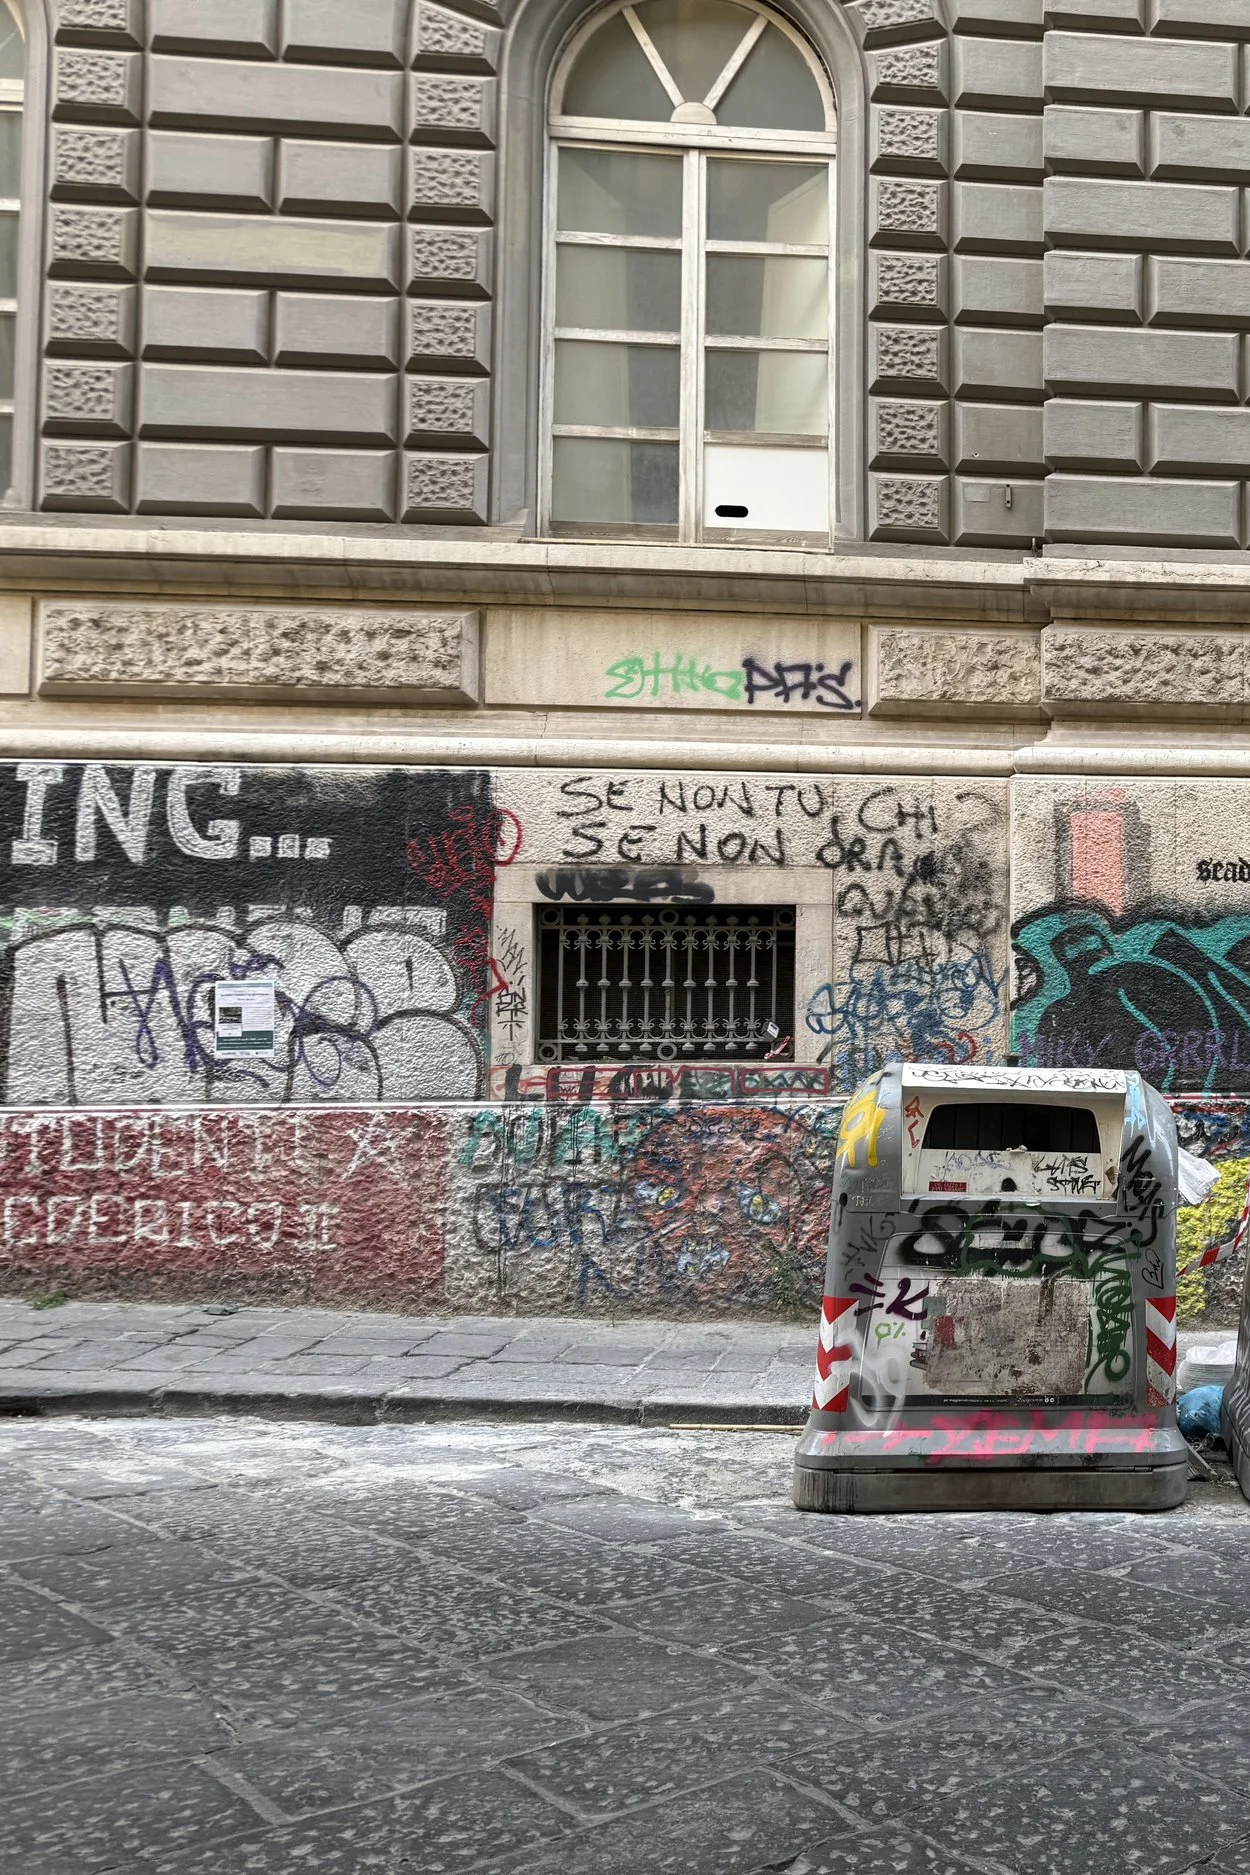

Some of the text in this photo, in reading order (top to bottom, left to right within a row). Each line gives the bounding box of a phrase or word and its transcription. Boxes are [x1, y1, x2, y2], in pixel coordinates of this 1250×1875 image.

[556, 777, 634, 816] SE
[658, 780, 754, 817] NON
[857, 786, 938, 839] CHI
[562, 822, 657, 862] SE
[676, 824, 786, 865] NON
